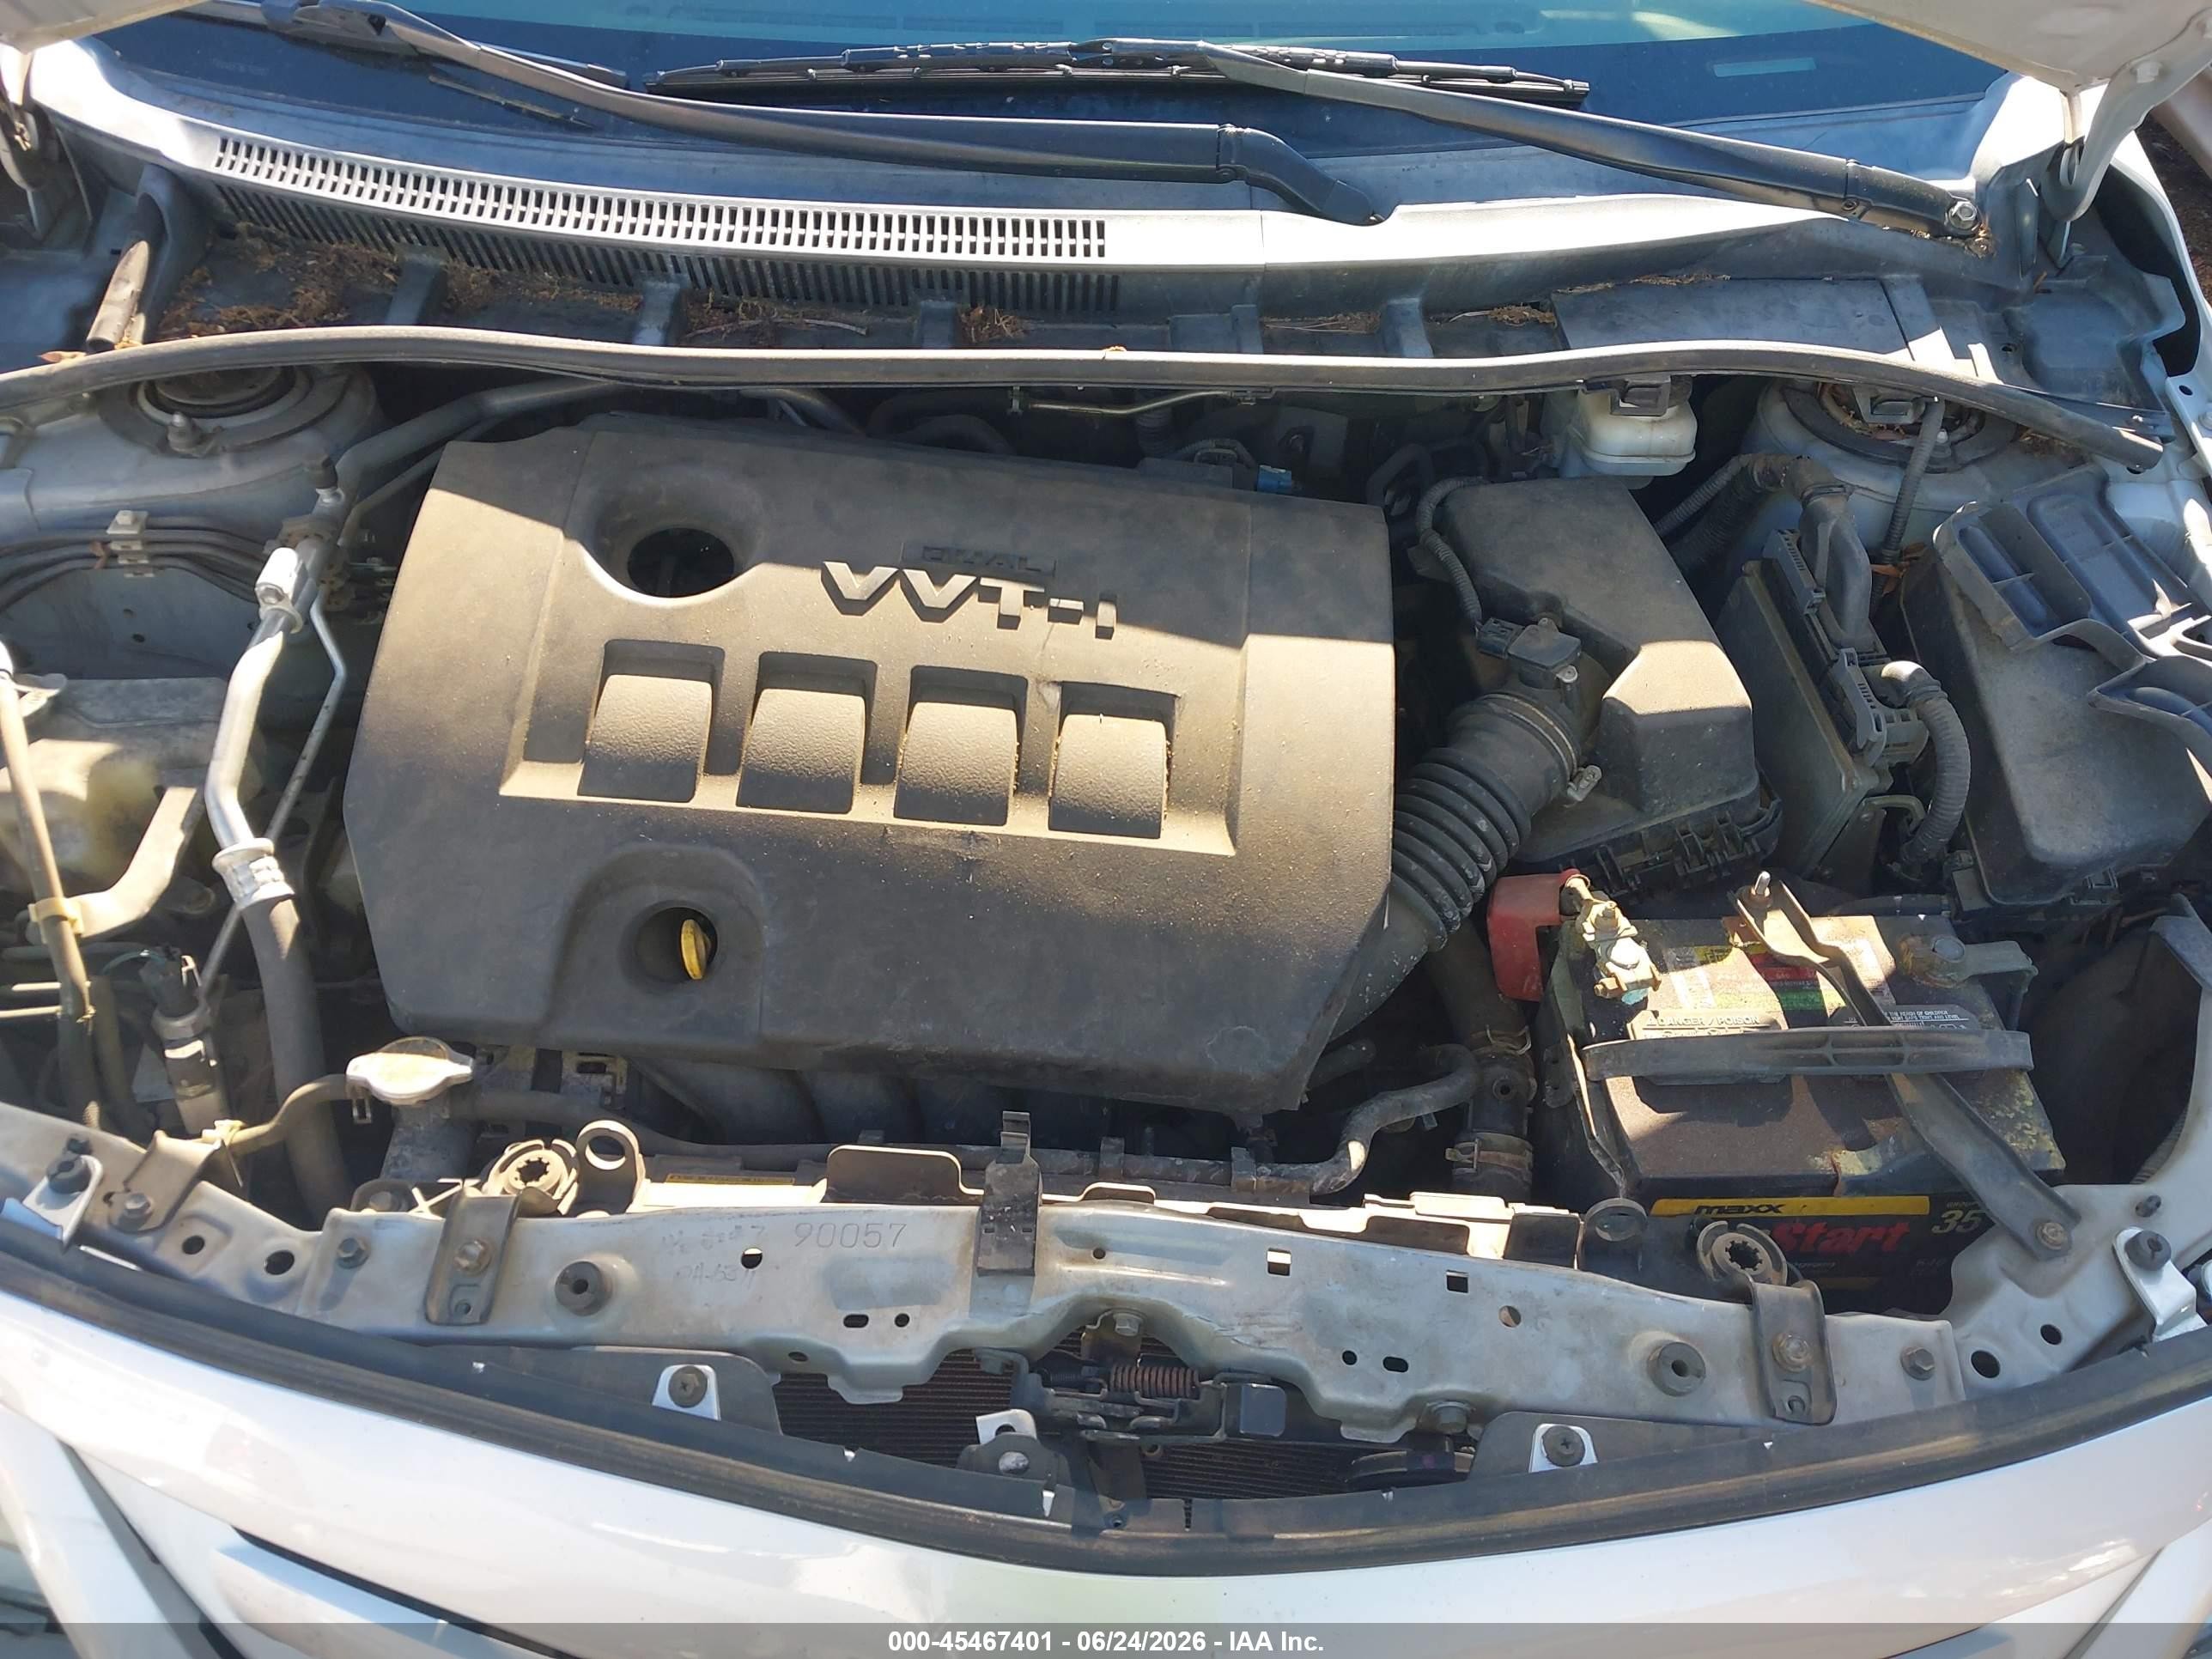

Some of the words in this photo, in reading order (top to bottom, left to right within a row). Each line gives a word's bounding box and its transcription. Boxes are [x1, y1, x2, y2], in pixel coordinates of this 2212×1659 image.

[1658, 1017, 1705, 1026] DANGER
[1717, 1016, 1760, 1025] POISON
[1694, 1204, 1785, 1215] maxx
[1931, 1209, 1986, 1234] 35
[793, 1222, 907, 1249] 90057
